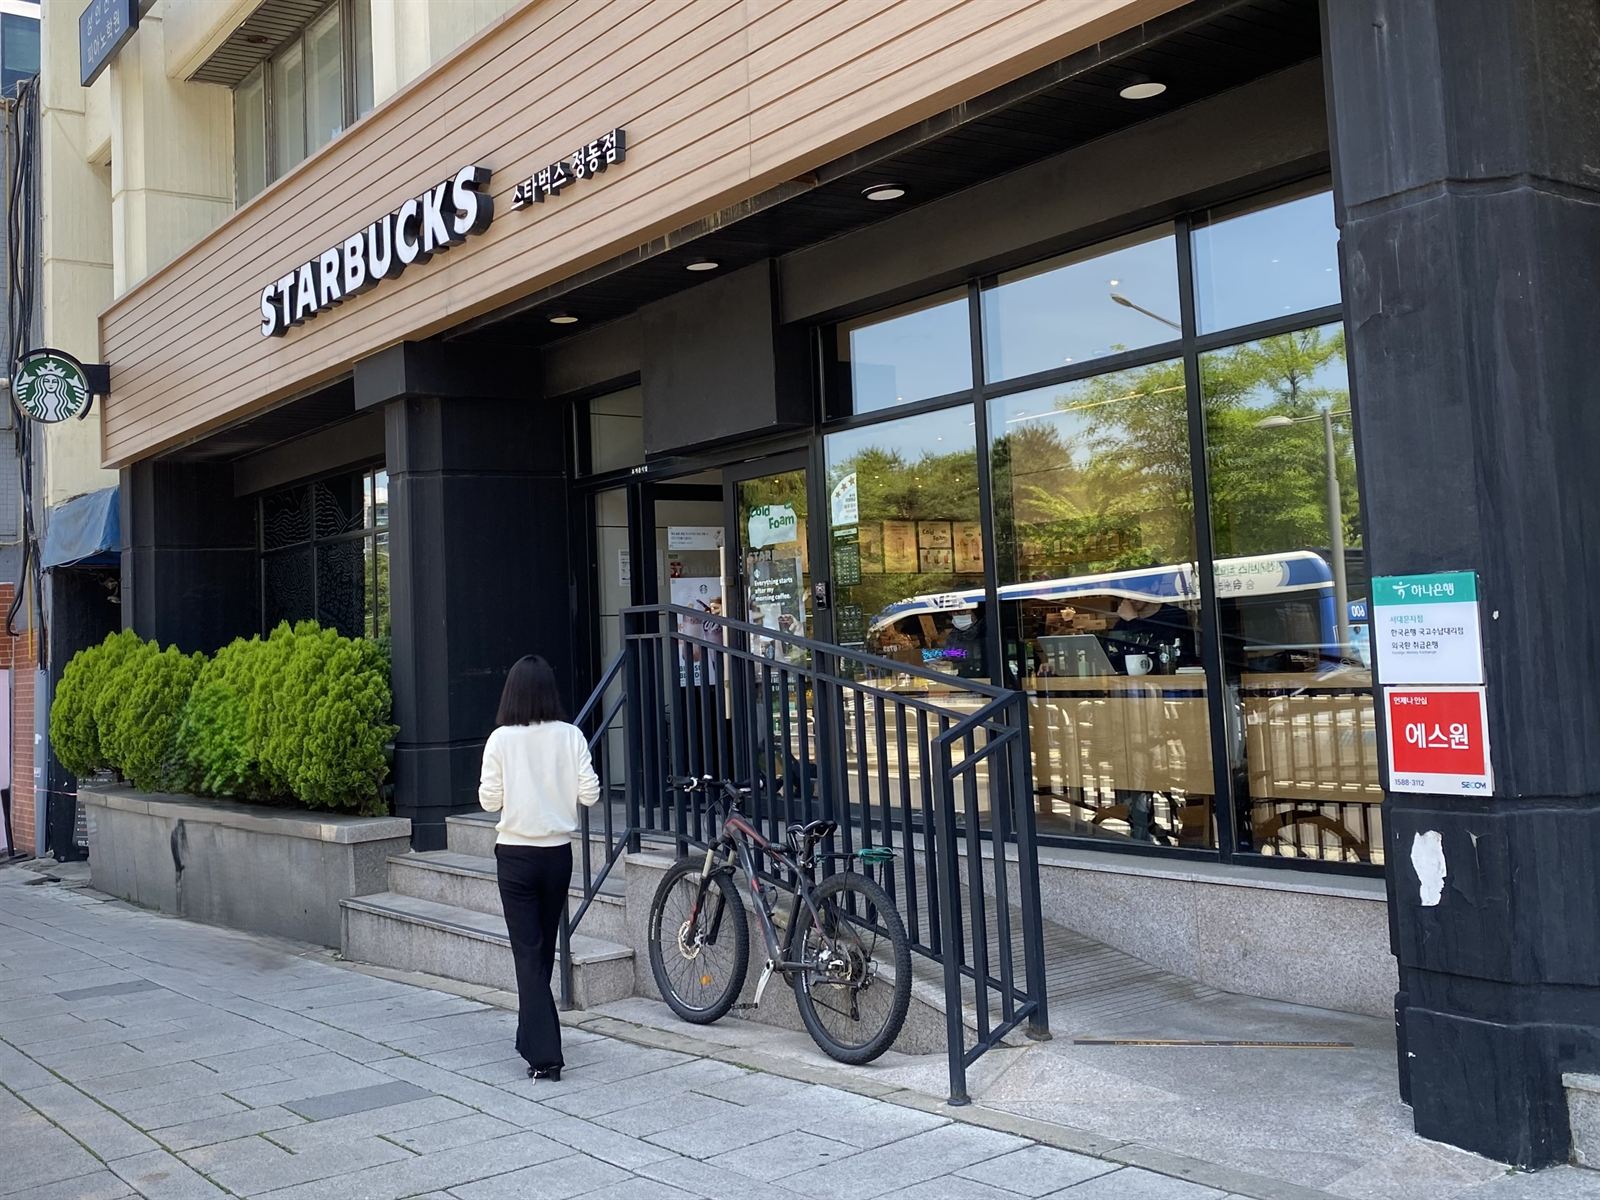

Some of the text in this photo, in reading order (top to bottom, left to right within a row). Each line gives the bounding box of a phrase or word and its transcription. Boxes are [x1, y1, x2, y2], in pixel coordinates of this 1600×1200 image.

[87, 9, 120, 63] 피아노학원
[511, 129, 618, 210] 스타벅스 정동점
[260, 165, 482, 337] STARBUCKS
[768, 515, 795, 529] Foam
[754, 578, 779, 587] Everything
[1410, 583, 1455, 597] 하나은행
[1389, 614, 1424, 624] 서대문지점
[1390, 627, 1464, 637] 한국은행 국고수납대리점
[1391, 641, 1439, 650] 외국환 취급은행
[1393, 696, 1428, 705] 언제나 안심
[1405, 723, 1469, 749] 에스원
[1394, 778, 1487, 789] 1588-3112 SECOM
